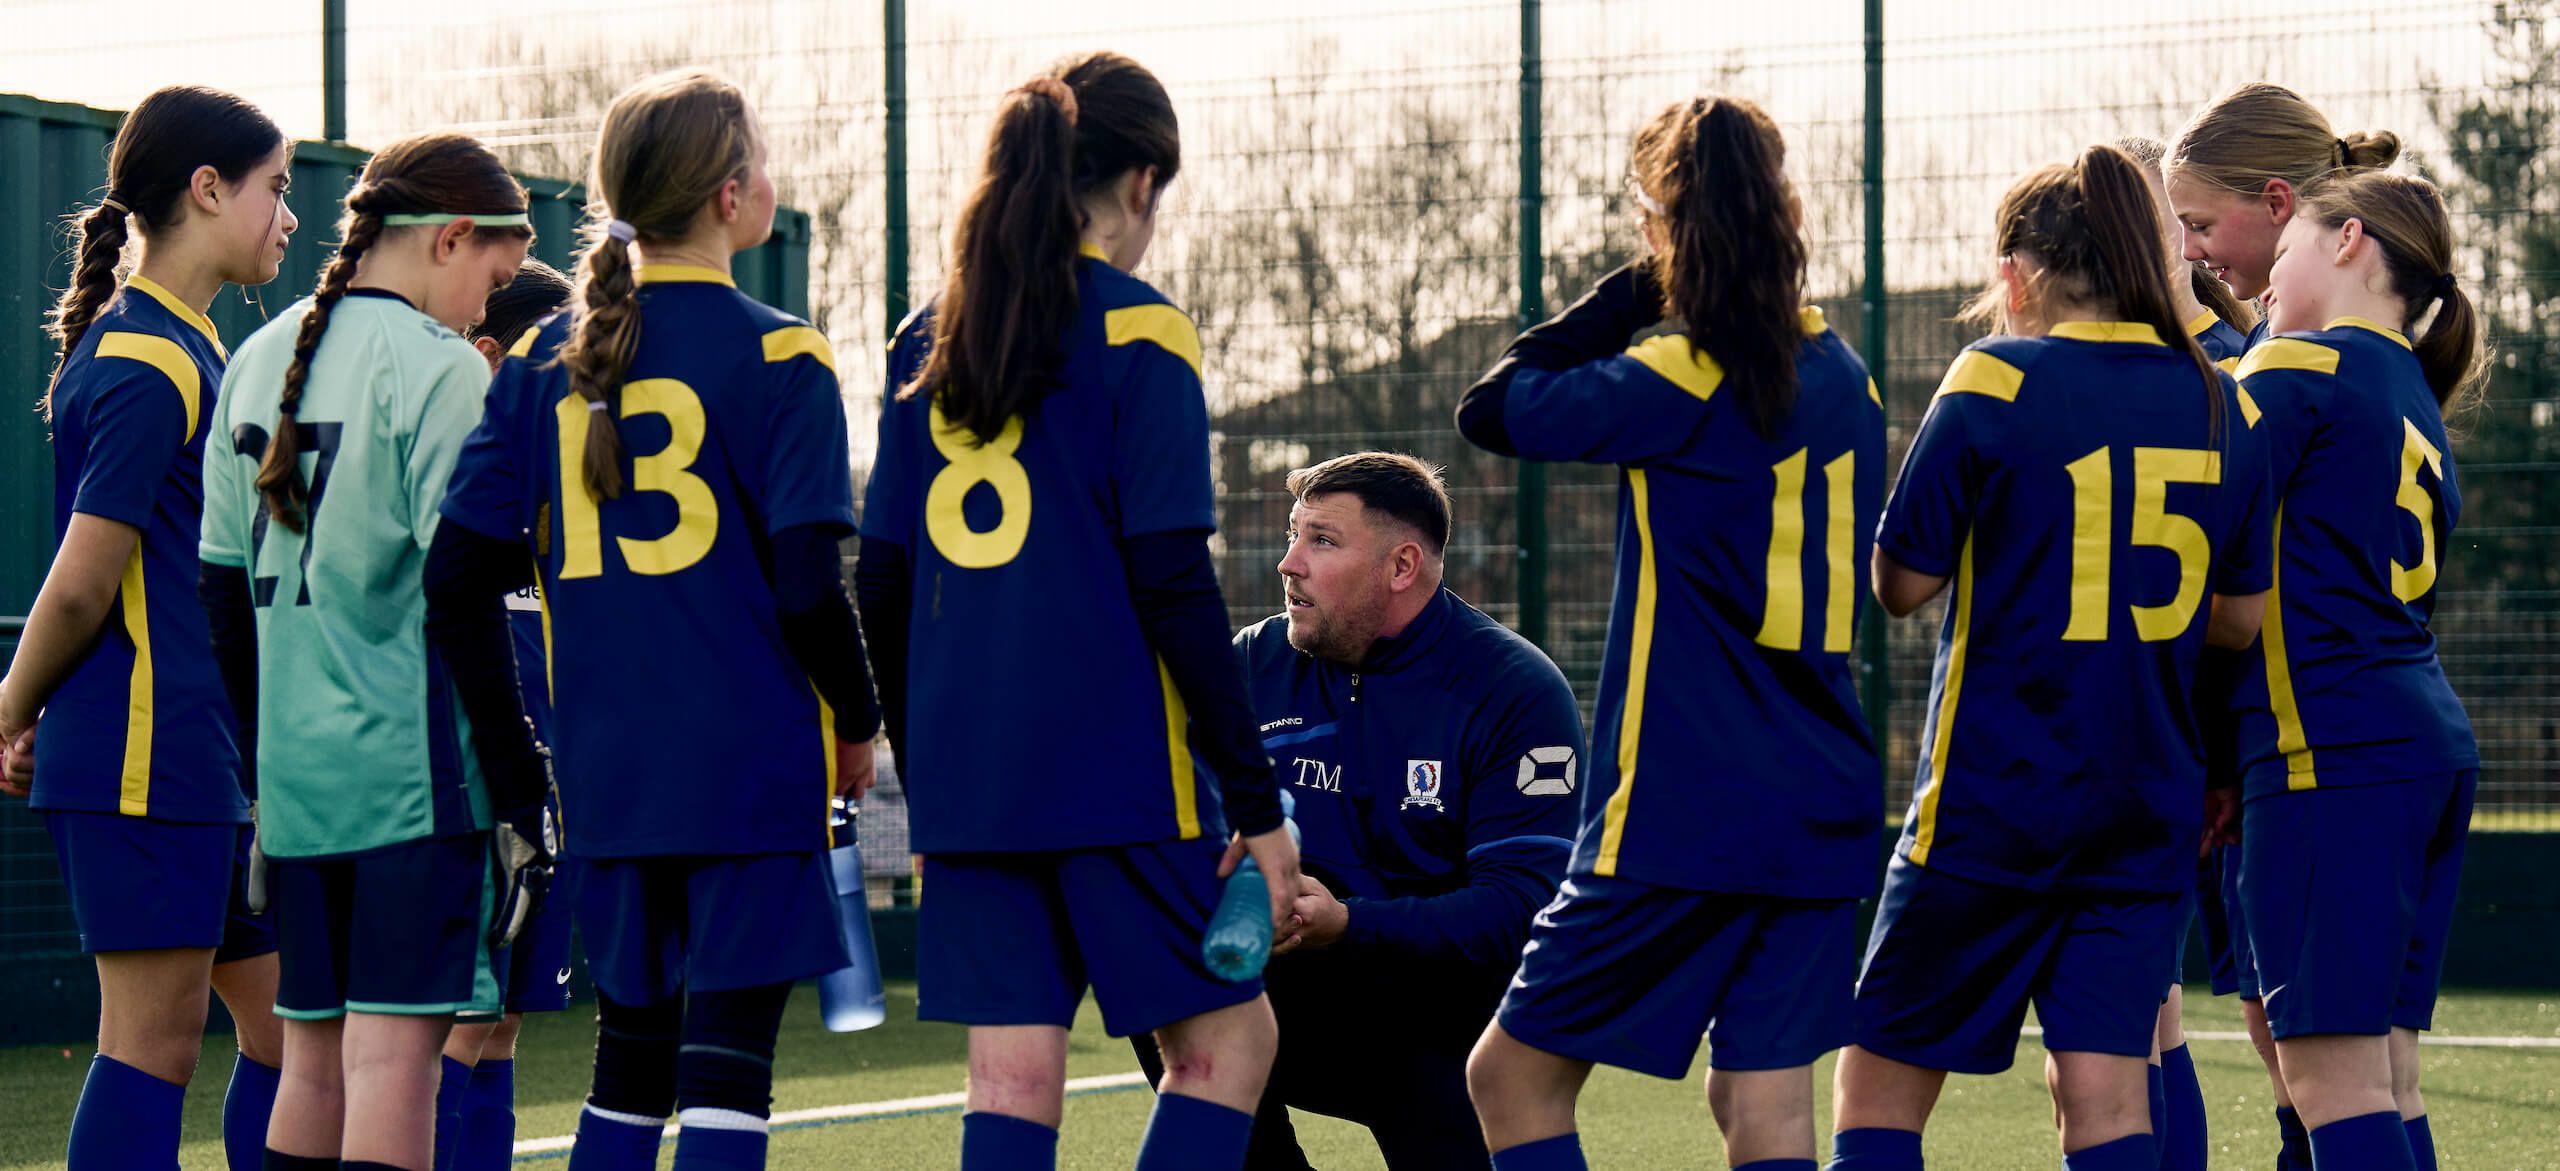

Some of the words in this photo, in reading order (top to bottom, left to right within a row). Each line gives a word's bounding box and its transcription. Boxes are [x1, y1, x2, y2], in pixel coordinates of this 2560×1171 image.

[232, 422, 343, 607] 27
[555, 377, 719, 579] 13
[925, 386, 1031, 568] 8
[1755, 446, 1854, 652] 11
[2061, 446, 2221, 642] 15
[2391, 416, 2442, 604] 5
[1260, 717, 1303, 732] STANNO
[1292, 757, 1342, 793] TM
